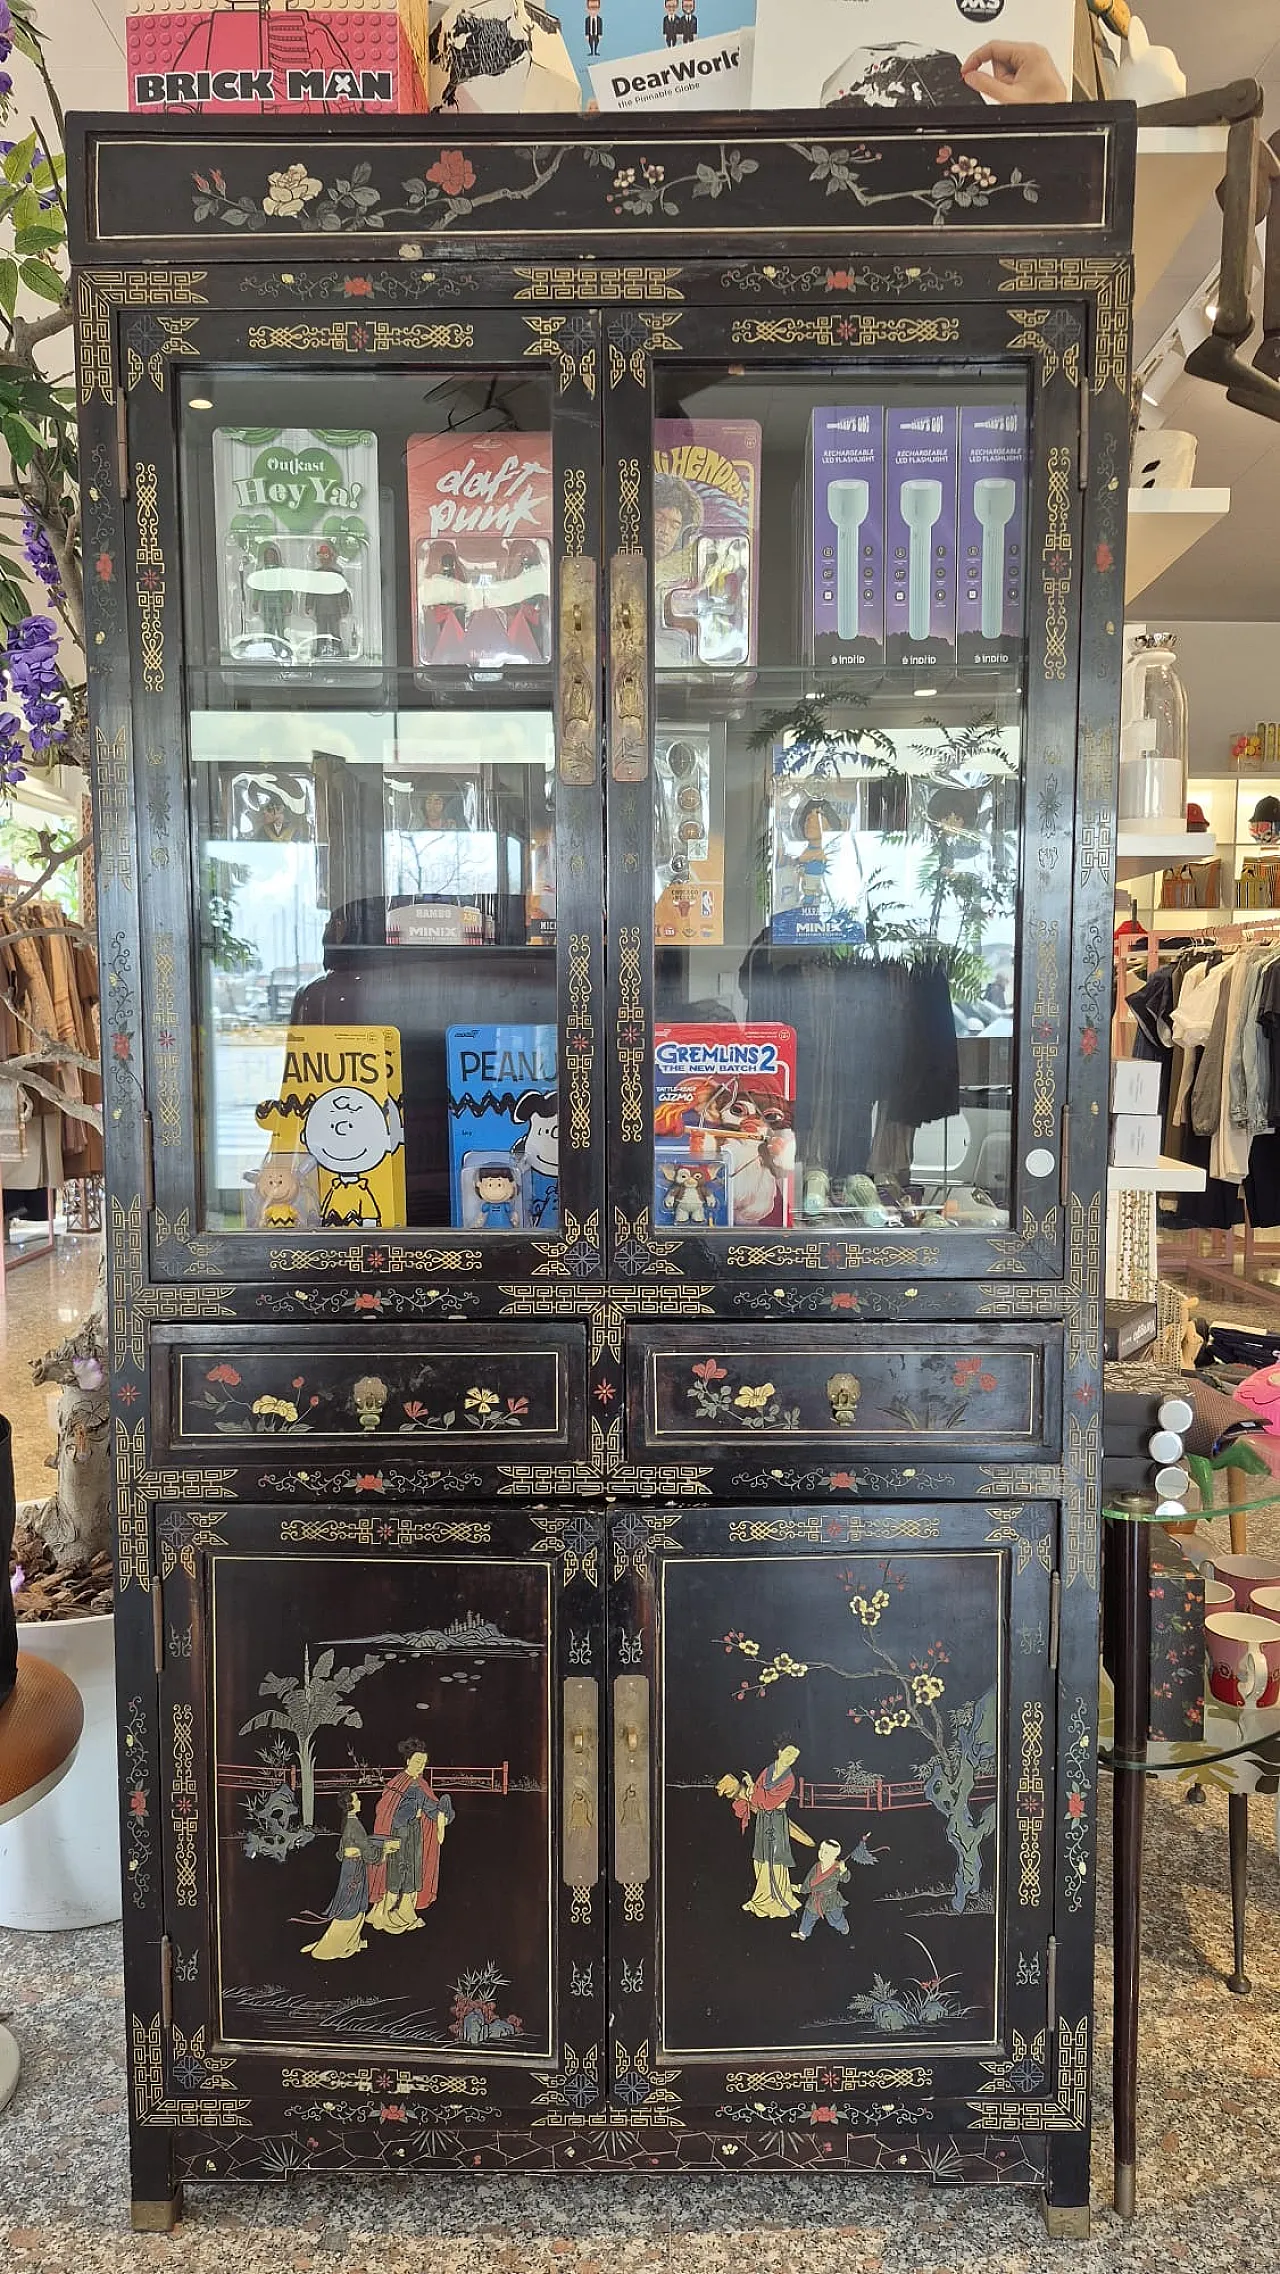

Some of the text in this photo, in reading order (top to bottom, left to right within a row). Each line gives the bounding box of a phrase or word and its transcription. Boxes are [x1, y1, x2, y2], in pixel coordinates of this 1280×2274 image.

[136, 69, 393, 105] BRICK MAN
[674, 82, 700, 94] Globe
[233, 476, 363, 510] Hey Ya!
[436, 455, 552, 504] daft
[428, 485, 549, 538] punk
[416, 909, 452, 919] RAMBO
[282, 1052, 379, 1084] ANUTS
[656, 1044, 777, 1072] GREMLINS 2
[662, 1064, 757, 1072] THE NEW BATCH
